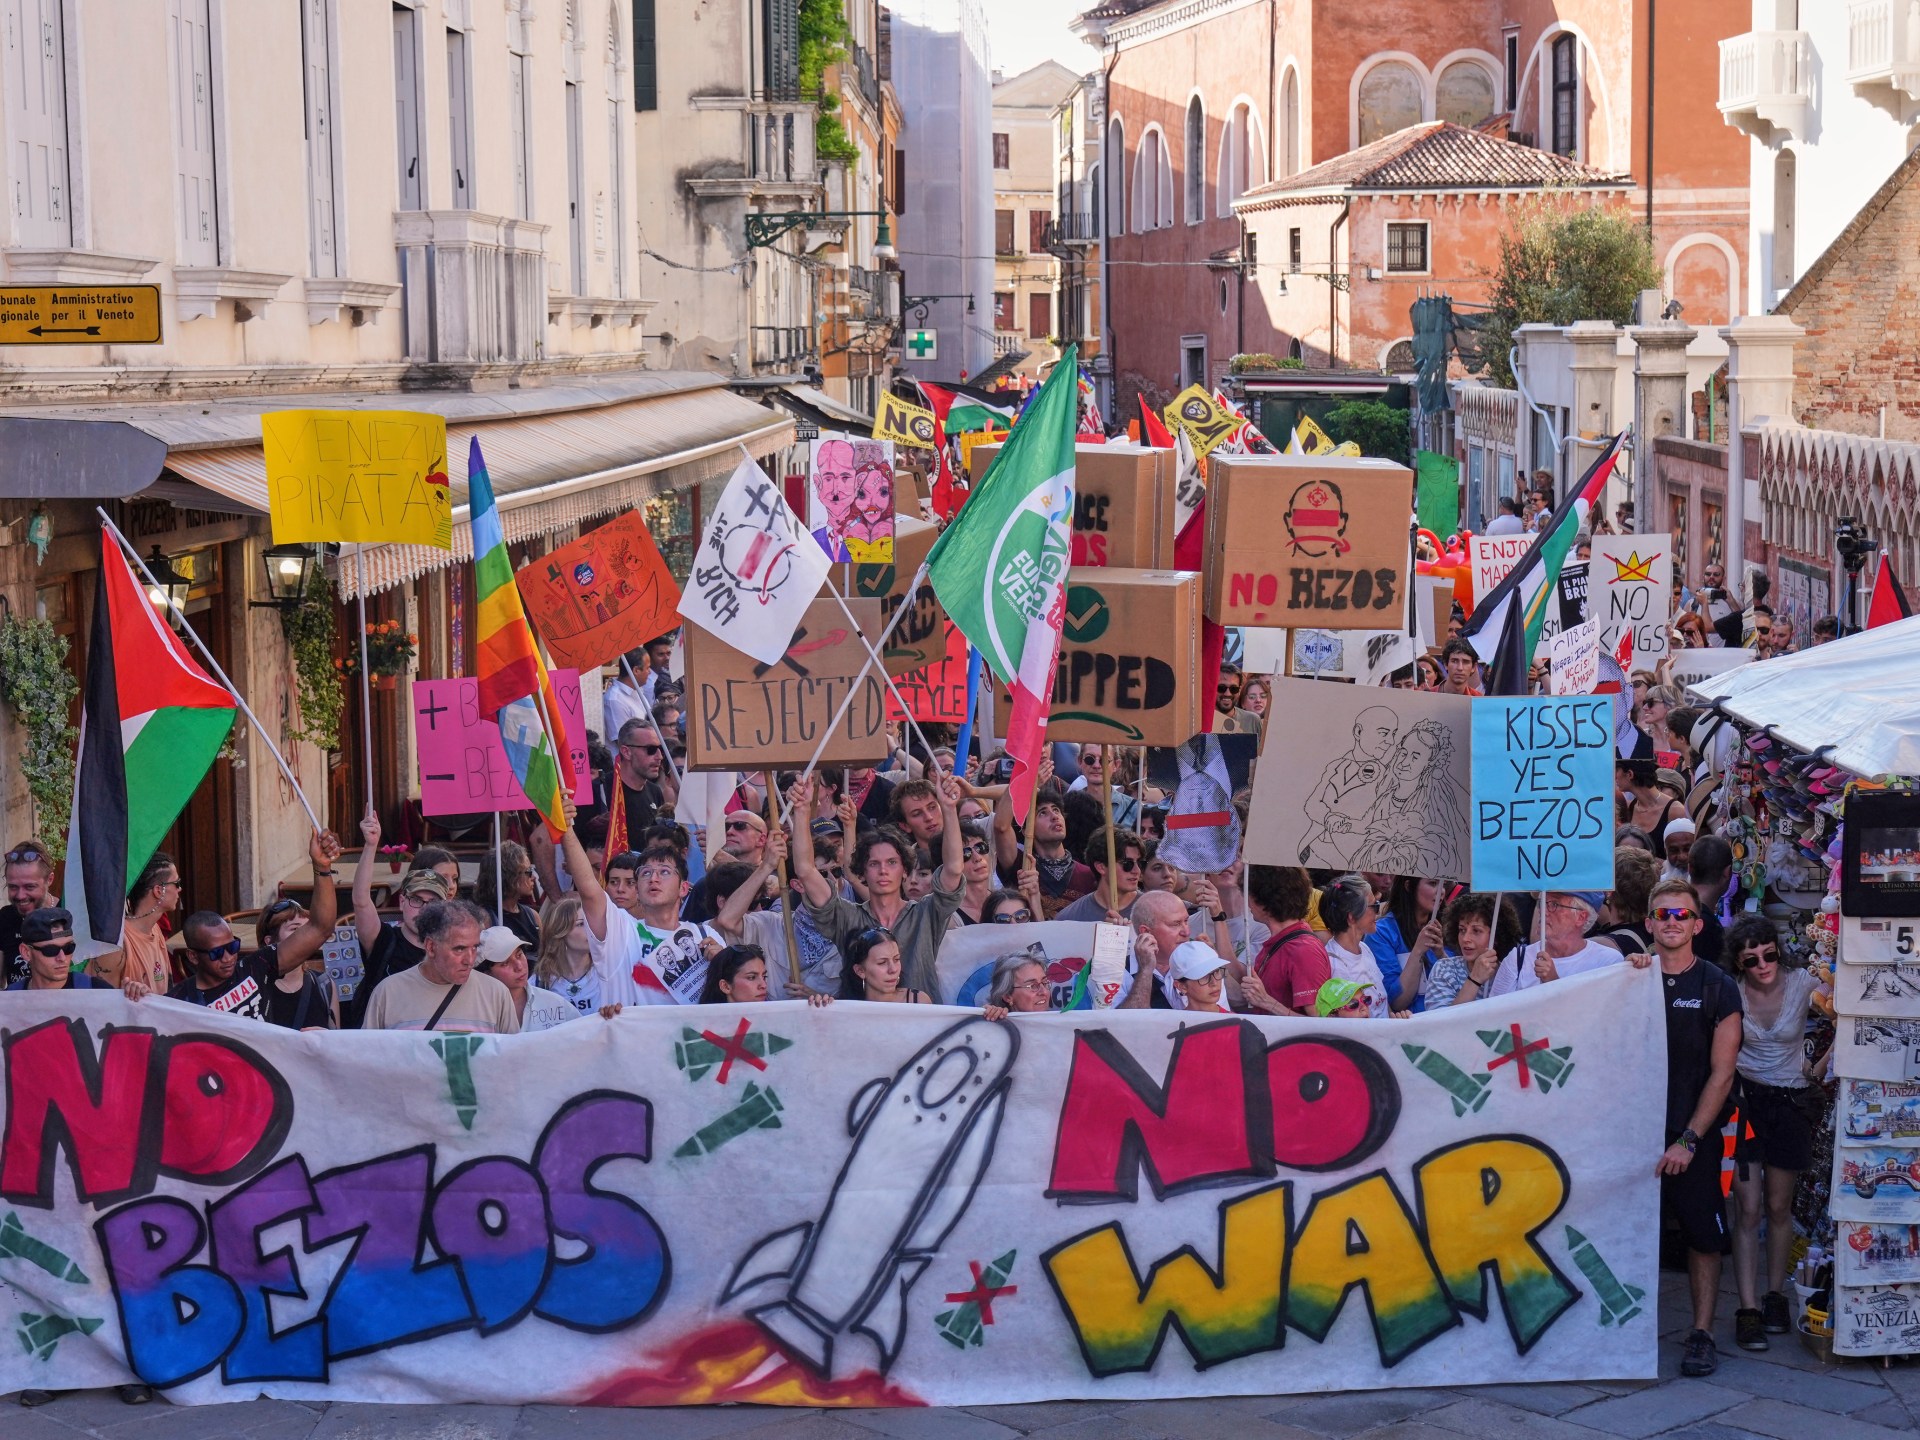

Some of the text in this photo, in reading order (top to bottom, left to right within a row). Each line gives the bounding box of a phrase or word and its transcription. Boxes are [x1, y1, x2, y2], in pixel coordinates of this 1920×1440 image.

[0, 293, 134, 305] bunale Amministrativo
[1, 308, 135, 323] gionale per il Veneto
[266, 417, 446, 464] VENEZIA
[884, 403, 934, 442] NO
[277, 471, 436, 528] PIRATA
[998, 561, 1032, 615] VER
[1230, 567, 1396, 610] NO BEZOS
[1563, 579, 1571, 589] IL
[1565, 584, 1588, 601] BRU
[1610, 586, 1649, 621] NO
[701, 674, 883, 751] REJECTED
[892, 681, 965, 717] STYLE
[1506, 702, 1608, 751] KISSES
[1510, 754, 1575, 793] YES
[1479, 797, 1604, 840] BEZOS
[1518, 842, 1568, 880] NO
[209, 979, 257, 1012] GINAL
[531, 1005, 565, 1025] POWE
[0, 1017, 294, 1209] NO
[1044, 1019, 1402, 1206] NO
[93, 1089, 672, 1389] BEZOS
[1039, 1133, 1583, 1378] WAR
[1855, 1310, 1920, 1328] VENEZIA
